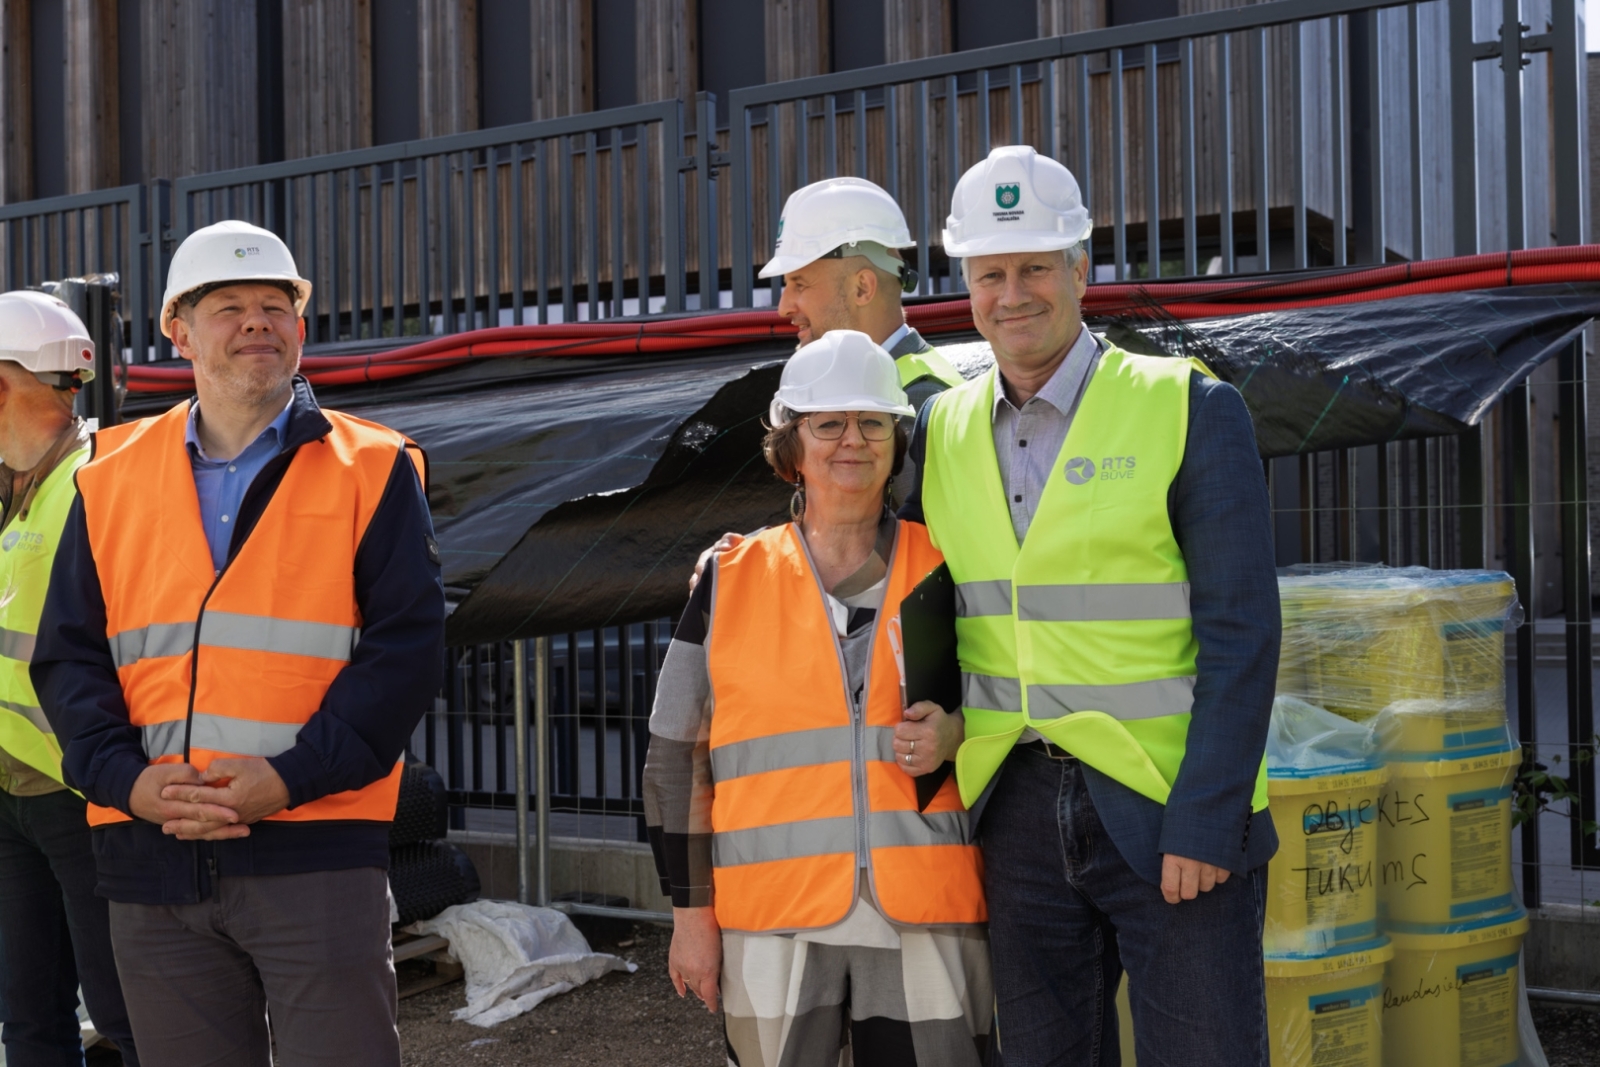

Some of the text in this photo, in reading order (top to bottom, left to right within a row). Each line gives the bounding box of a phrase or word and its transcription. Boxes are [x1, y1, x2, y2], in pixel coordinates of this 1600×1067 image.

[1101, 456, 1136, 470] RTS
[1100, 470, 1134, 481] BŪVE
[23, 531, 43, 544] RTS
